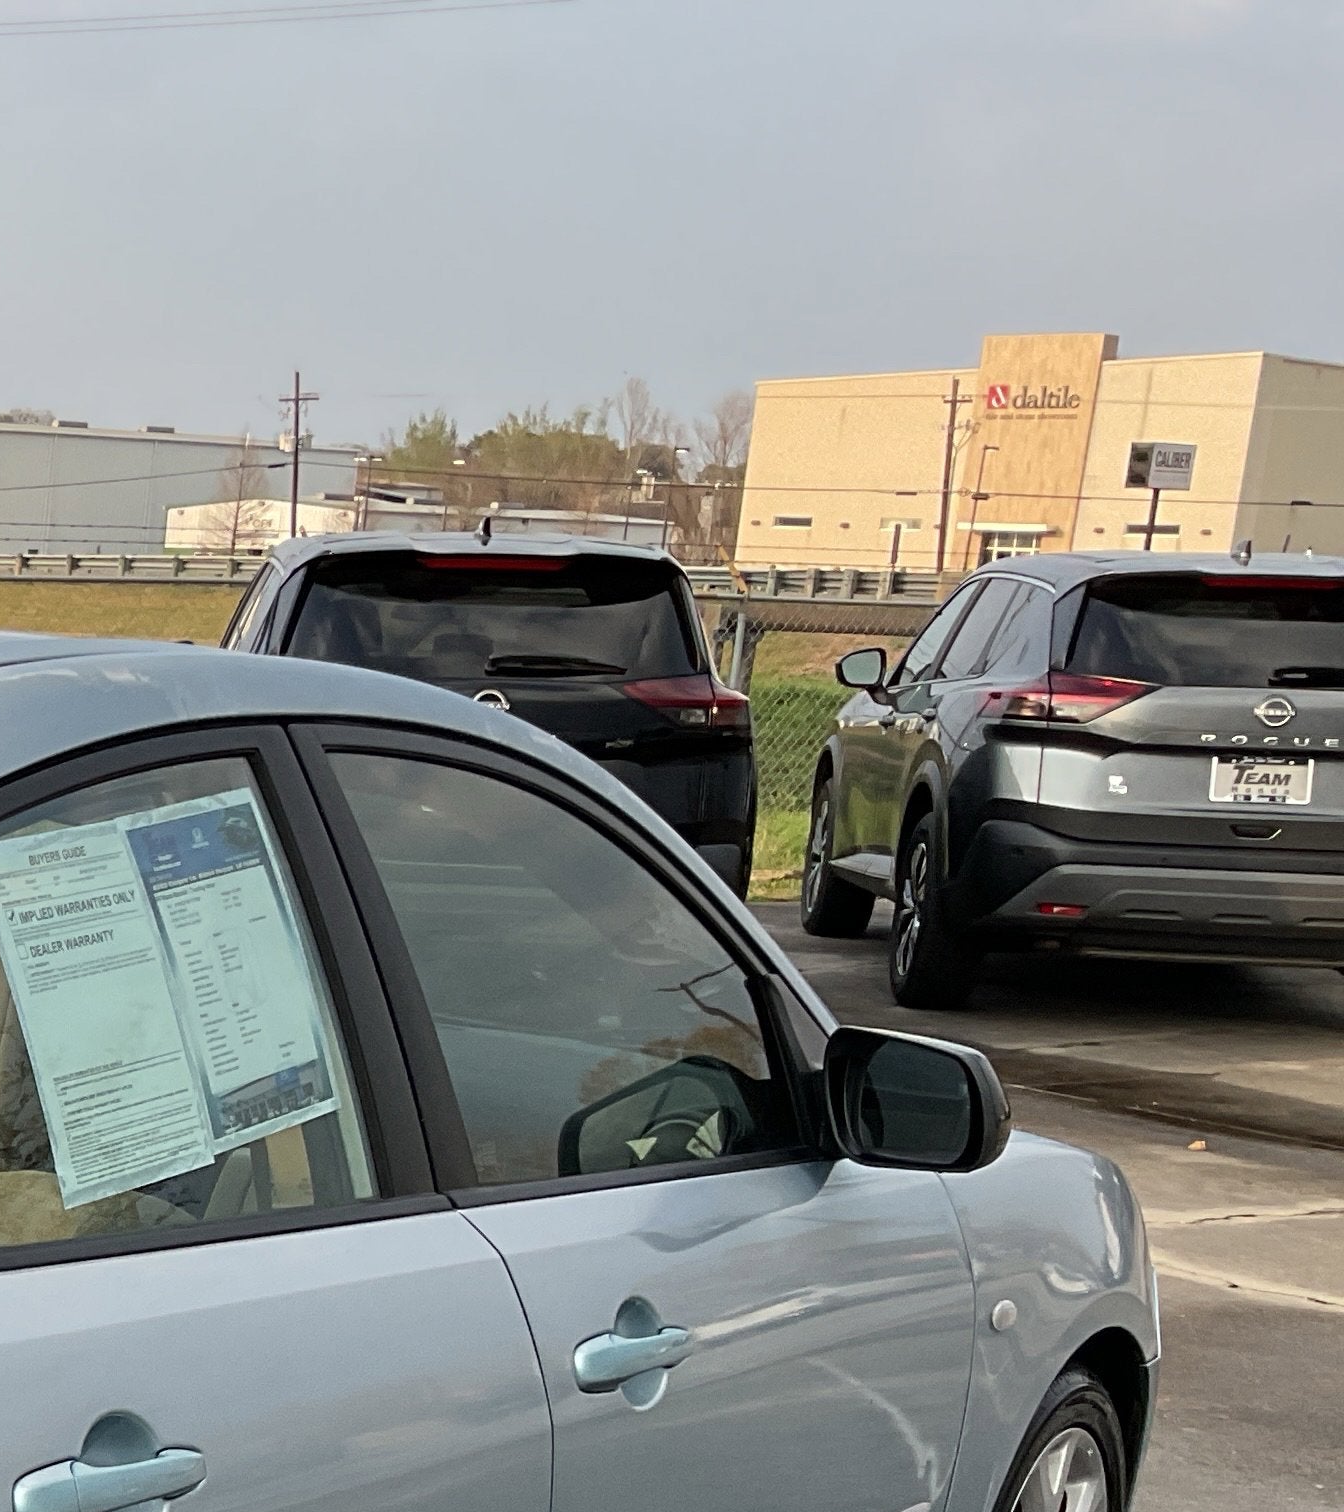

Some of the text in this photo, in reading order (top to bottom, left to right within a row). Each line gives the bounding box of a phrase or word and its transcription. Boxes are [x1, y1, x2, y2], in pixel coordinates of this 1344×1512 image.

[1013, 386, 1080, 409] daltile
[1232, 764, 1292, 786] TEAM
[28, 846, 87, 866] BUYERS GUIDE
[18, 906, 55, 924] IMPLIED
[54, 896, 113, 918] WARRANTIES
[112, 889, 136, 905] ONLY
[29, 941, 64, 958] DEALER
[64, 929, 114, 951] WARRANTY
